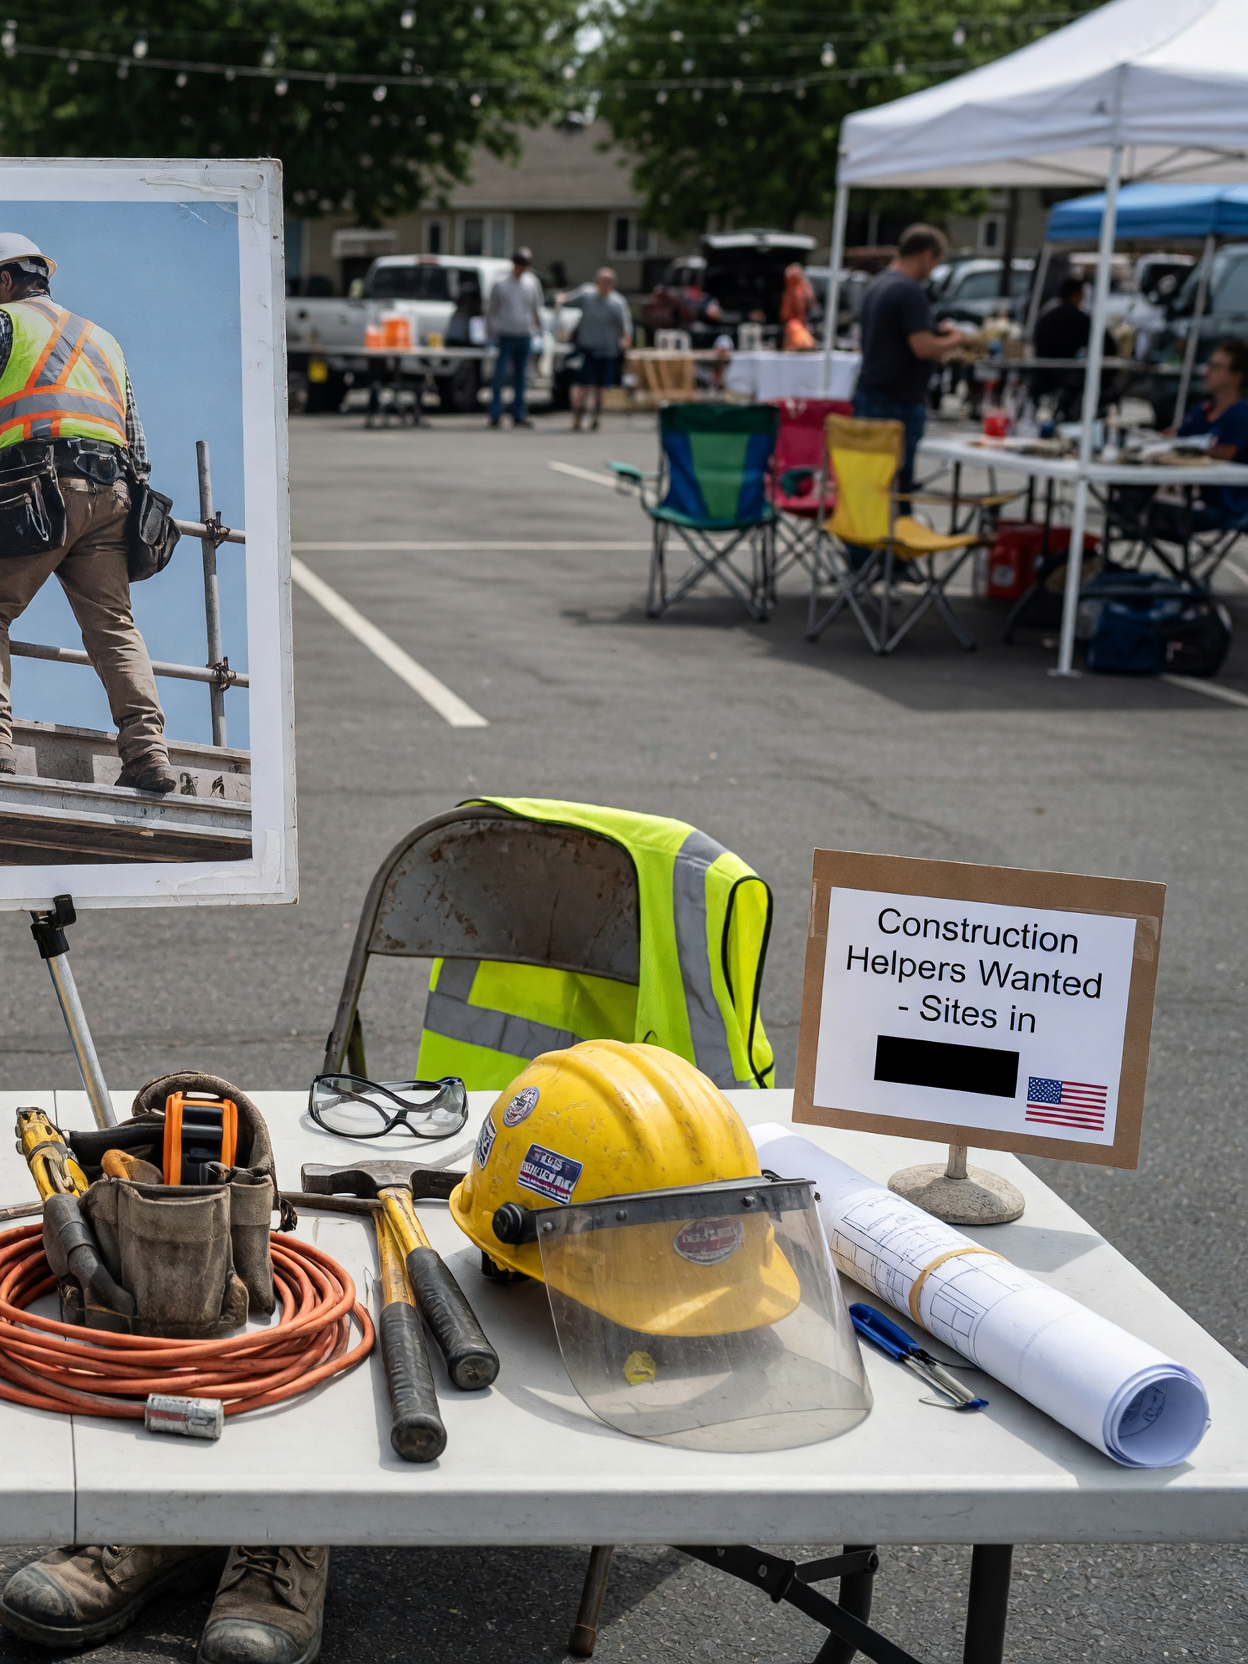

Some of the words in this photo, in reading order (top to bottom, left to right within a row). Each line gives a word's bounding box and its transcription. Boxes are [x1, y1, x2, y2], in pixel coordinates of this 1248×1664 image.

[878, 907, 1079, 955] Construction
[846, 944, 966, 984] Helpers
[979, 959, 1103, 999] Wanted
[919, 994, 998, 1029] Sites
[1009, 1003, 1036, 1034] in
